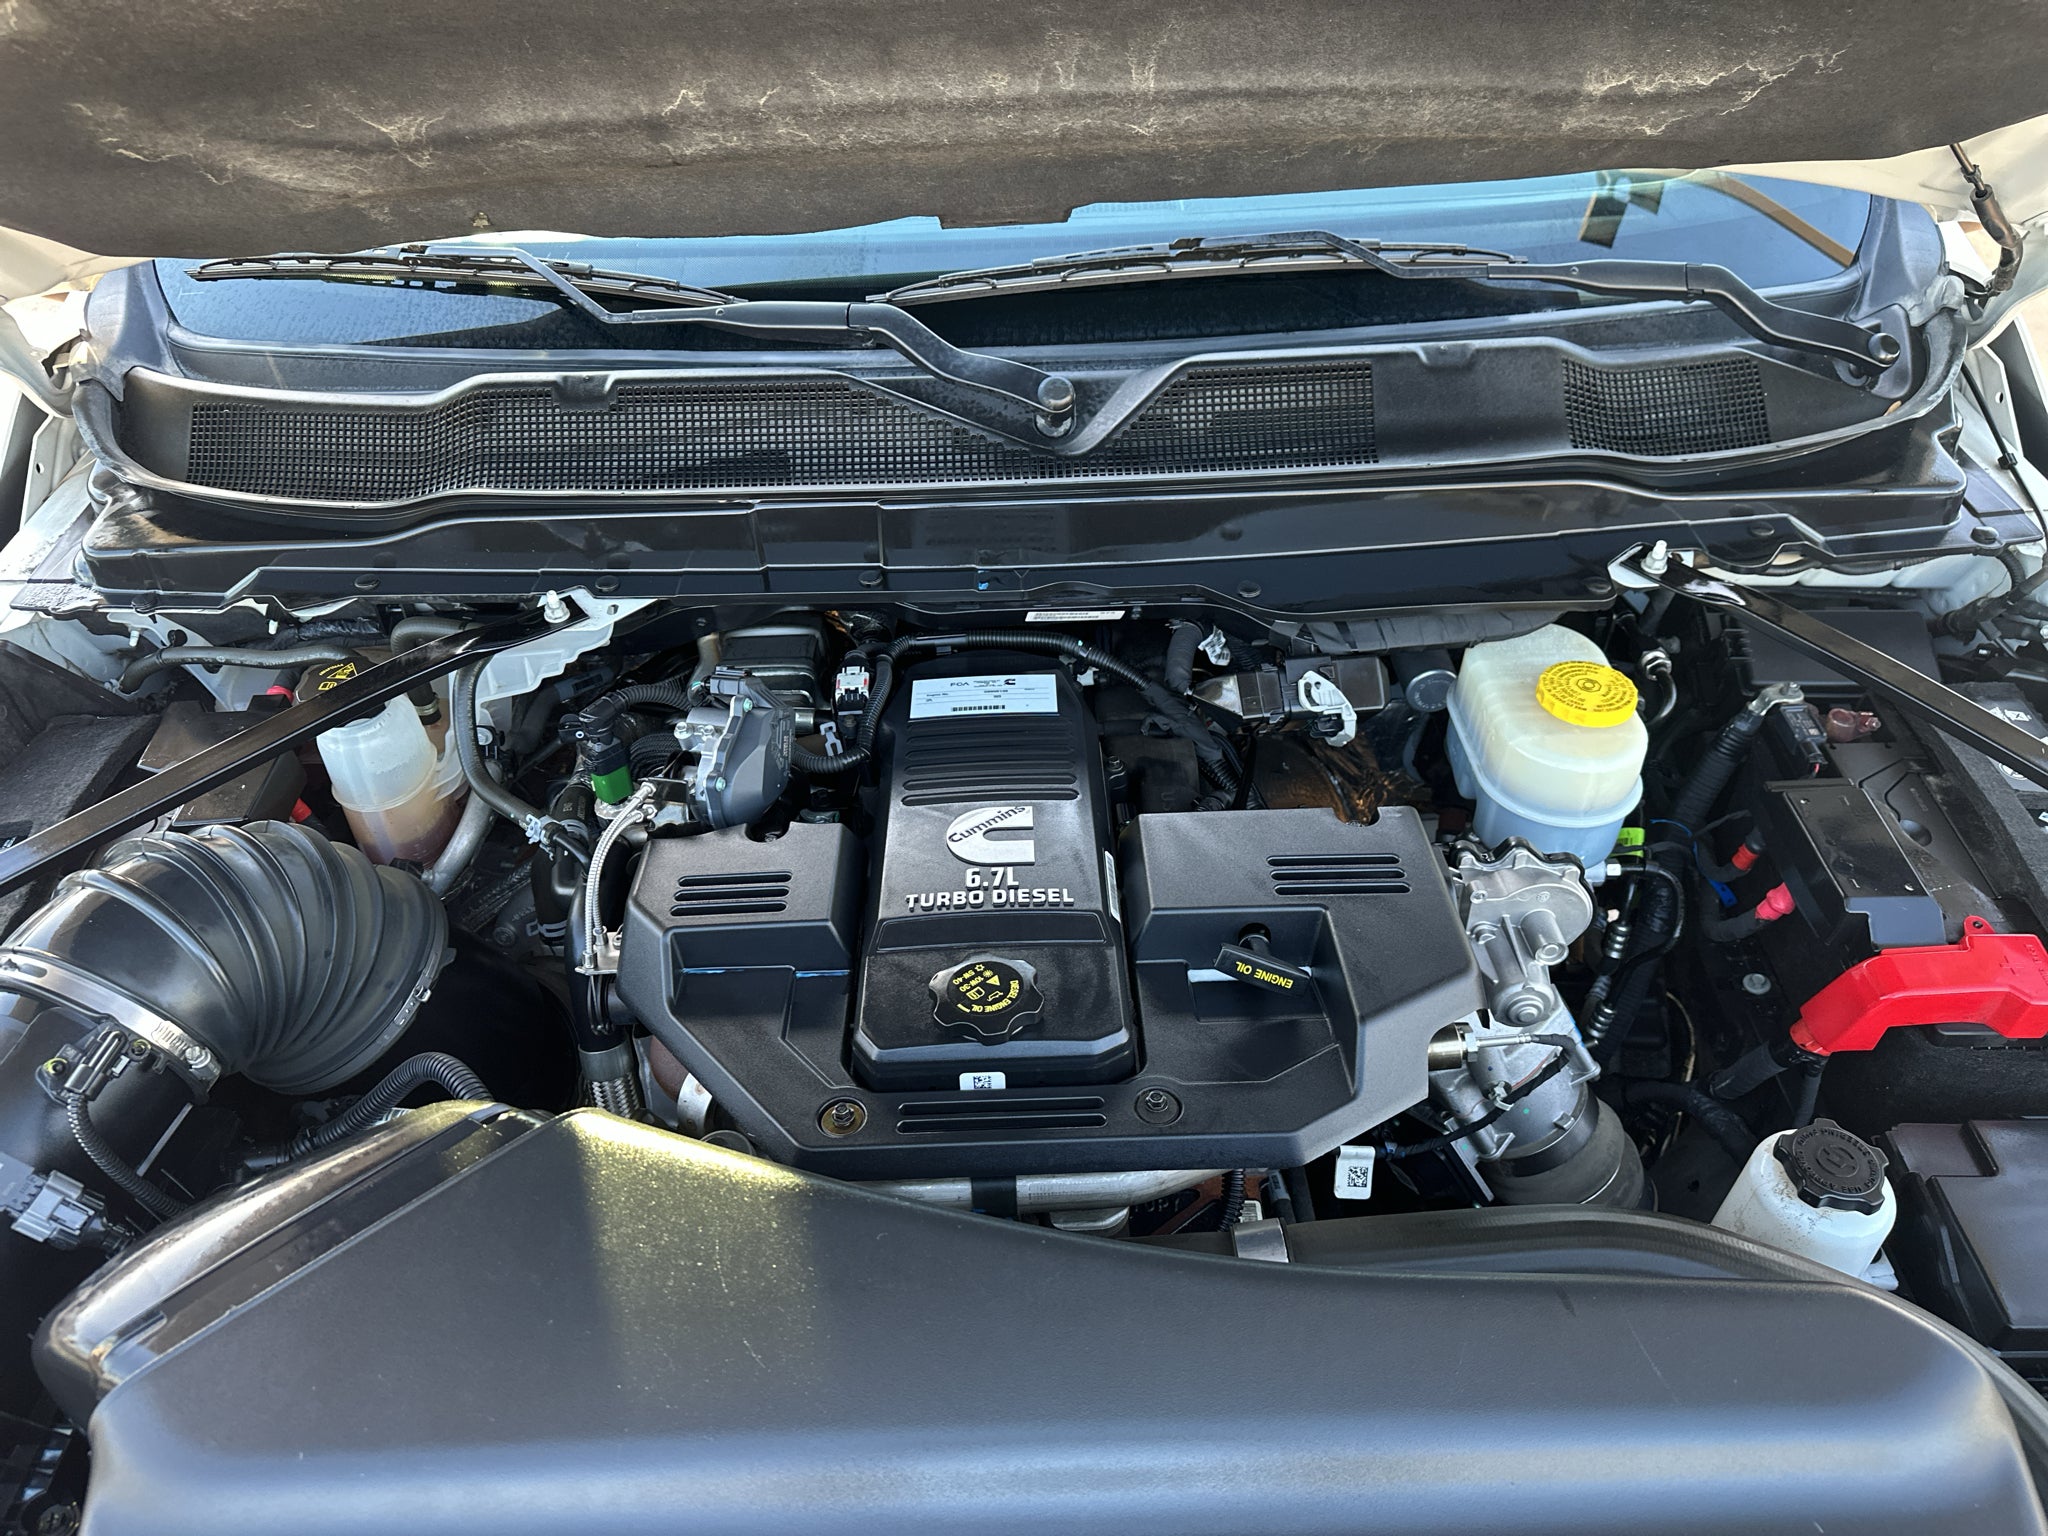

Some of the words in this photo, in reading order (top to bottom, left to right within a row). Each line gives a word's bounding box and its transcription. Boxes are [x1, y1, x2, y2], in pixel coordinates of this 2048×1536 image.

[948, 806, 1026, 843] Cummins
[966, 867, 1019, 889] 6.7L
[905, 890, 985, 911] TURBO
[992, 888, 1075, 907] DIESEL
[1235, 961, 1253, 975] OIL
[952, 969, 975, 985] 5W-40
[959, 976, 984, 992] 10W-30
[1253, 968, 1294, 989] ENGINE
[1006, 980, 1020, 999] DIESEL
[971, 1004, 983, 1013] OIL
[984, 998, 1012, 1013] ENGINE
